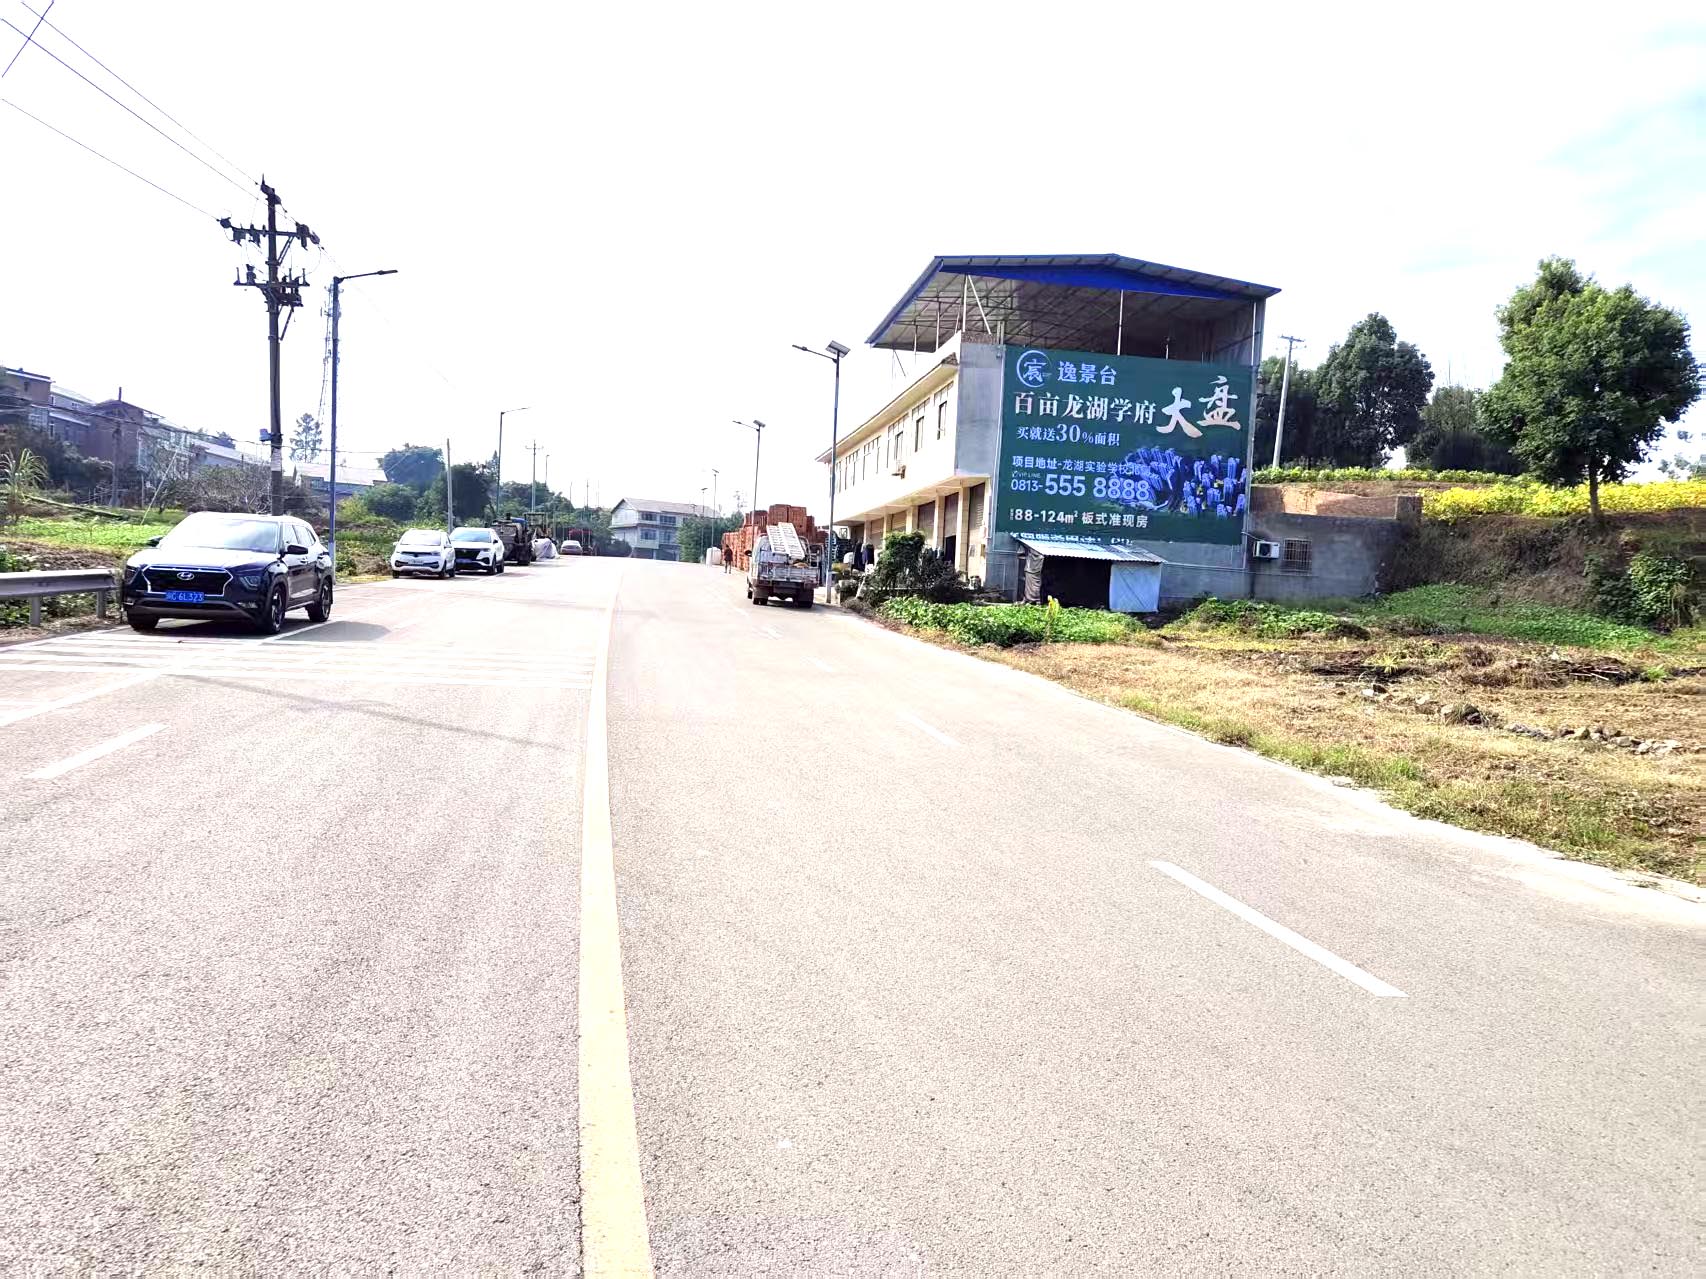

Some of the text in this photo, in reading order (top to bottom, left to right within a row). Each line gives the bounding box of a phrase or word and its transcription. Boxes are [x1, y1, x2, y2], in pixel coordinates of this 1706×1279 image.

[1057, 361, 1117, 386] 逸景台
[1014, 375, 1241, 438] 百亩龙湖学府 大盘
[1016, 423, 1120, 446] 买就送30%面积
[1092, 477, 1150, 501] 8888
[1081, 511, 1148, 528] 板式准现房
